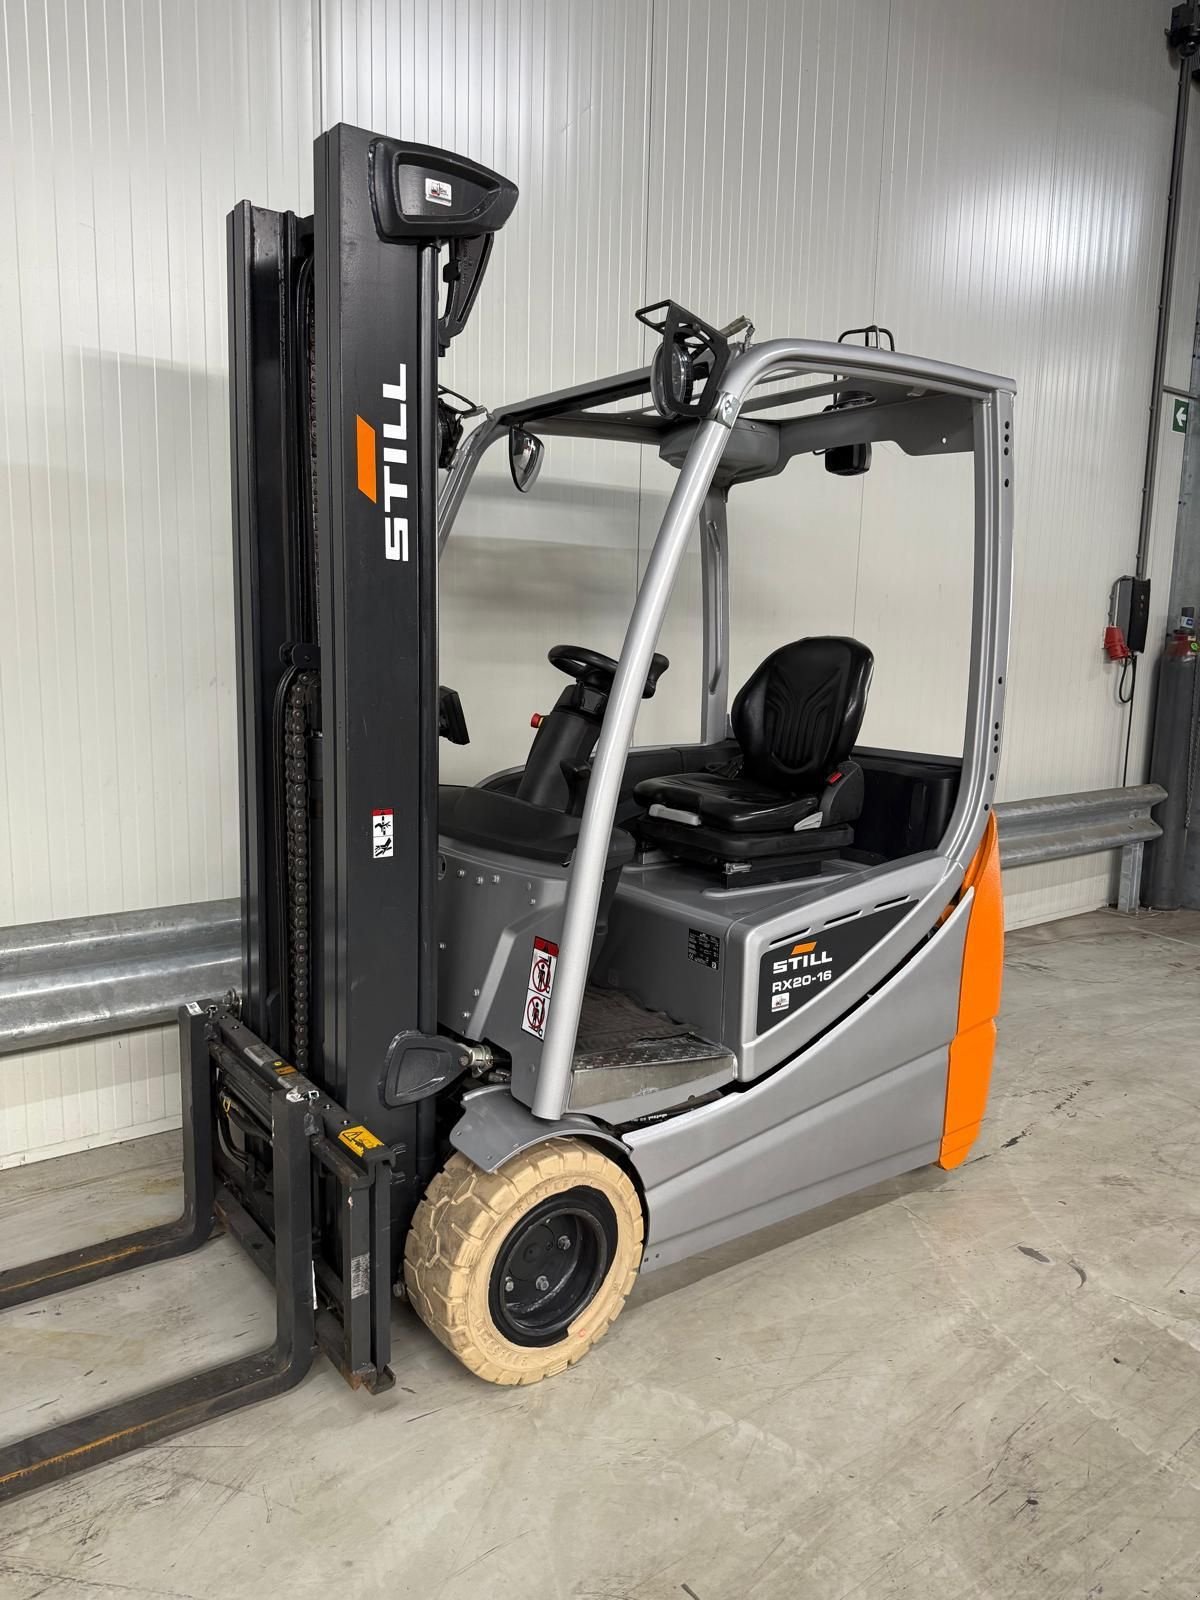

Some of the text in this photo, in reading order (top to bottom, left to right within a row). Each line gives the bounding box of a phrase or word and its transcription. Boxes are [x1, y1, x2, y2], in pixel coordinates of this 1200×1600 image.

[383, 363, 409, 562] STILL
[773, 951, 833, 974] STILL
[772, 970, 832, 993] RX20-16
